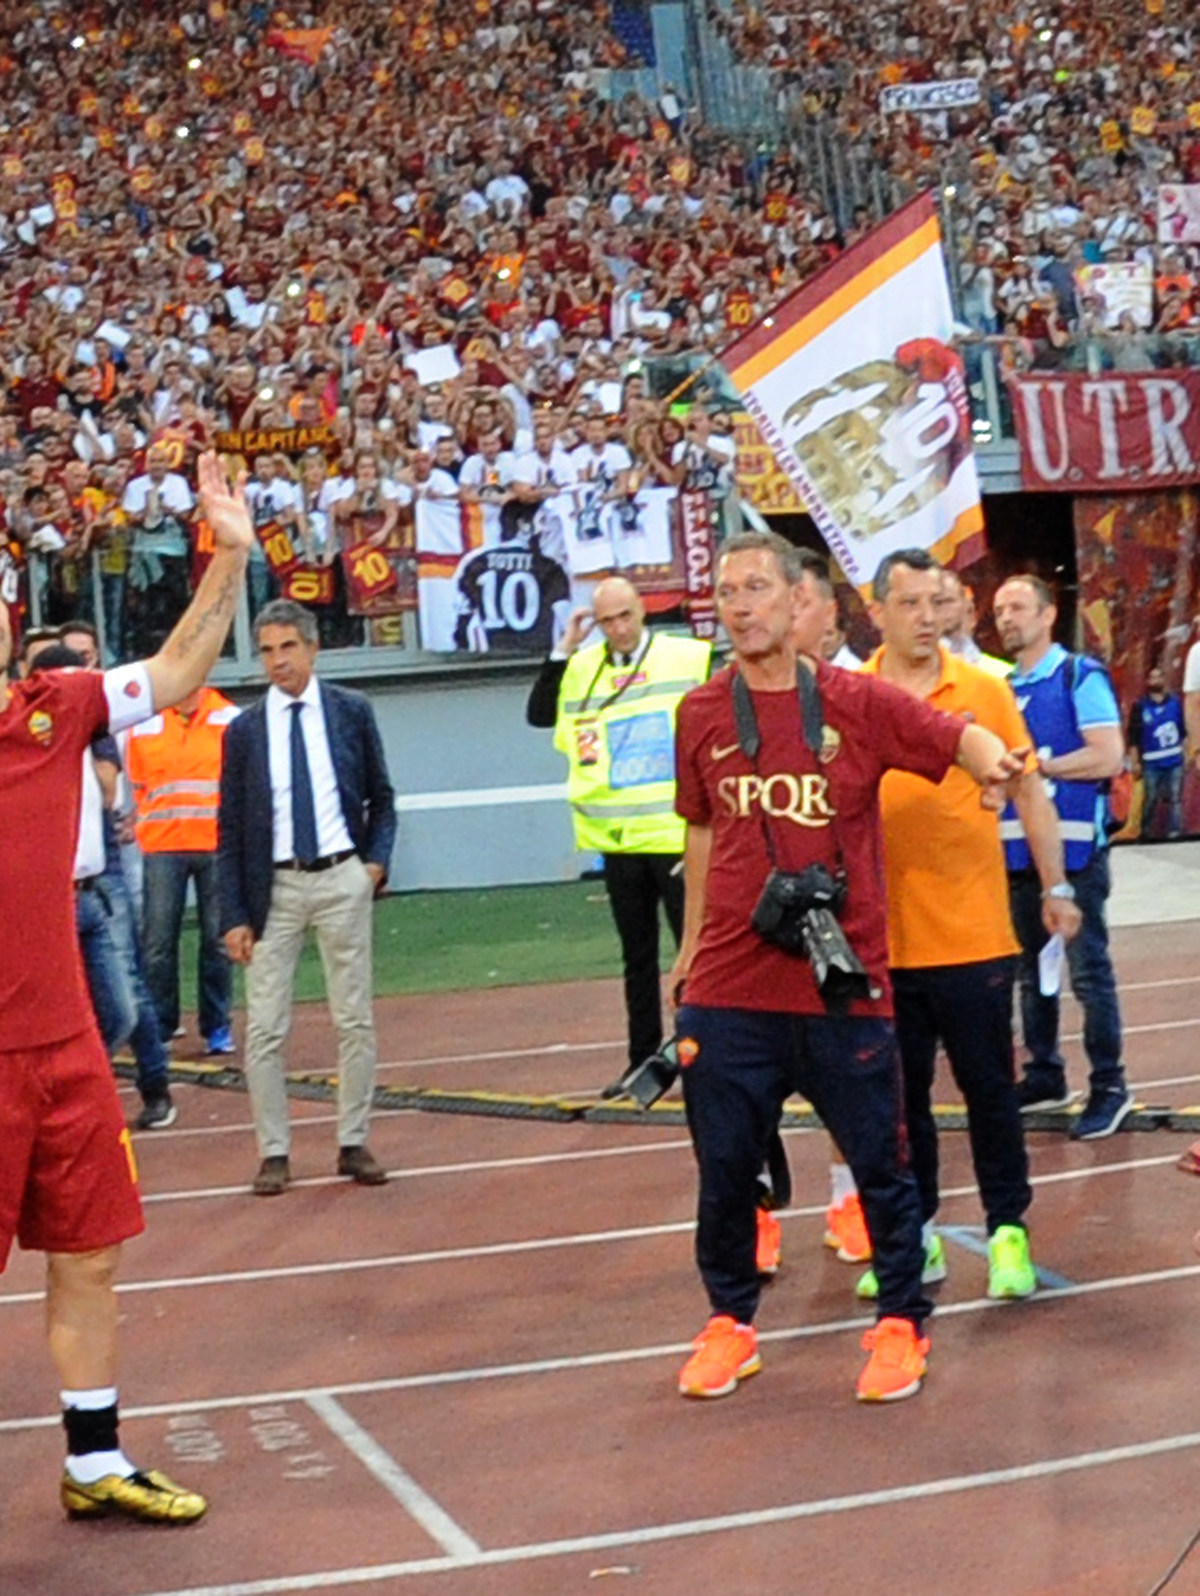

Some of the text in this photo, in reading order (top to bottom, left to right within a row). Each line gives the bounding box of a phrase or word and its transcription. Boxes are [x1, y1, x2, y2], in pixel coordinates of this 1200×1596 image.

[264, 531, 294, 566] 10
[487, 553, 534, 569] TOTTI
[289, 571, 320, 600] 10
[352, 553, 390, 588] 10
[477, 569, 540, 631] 10
[718, 774, 838, 827] SPQR
